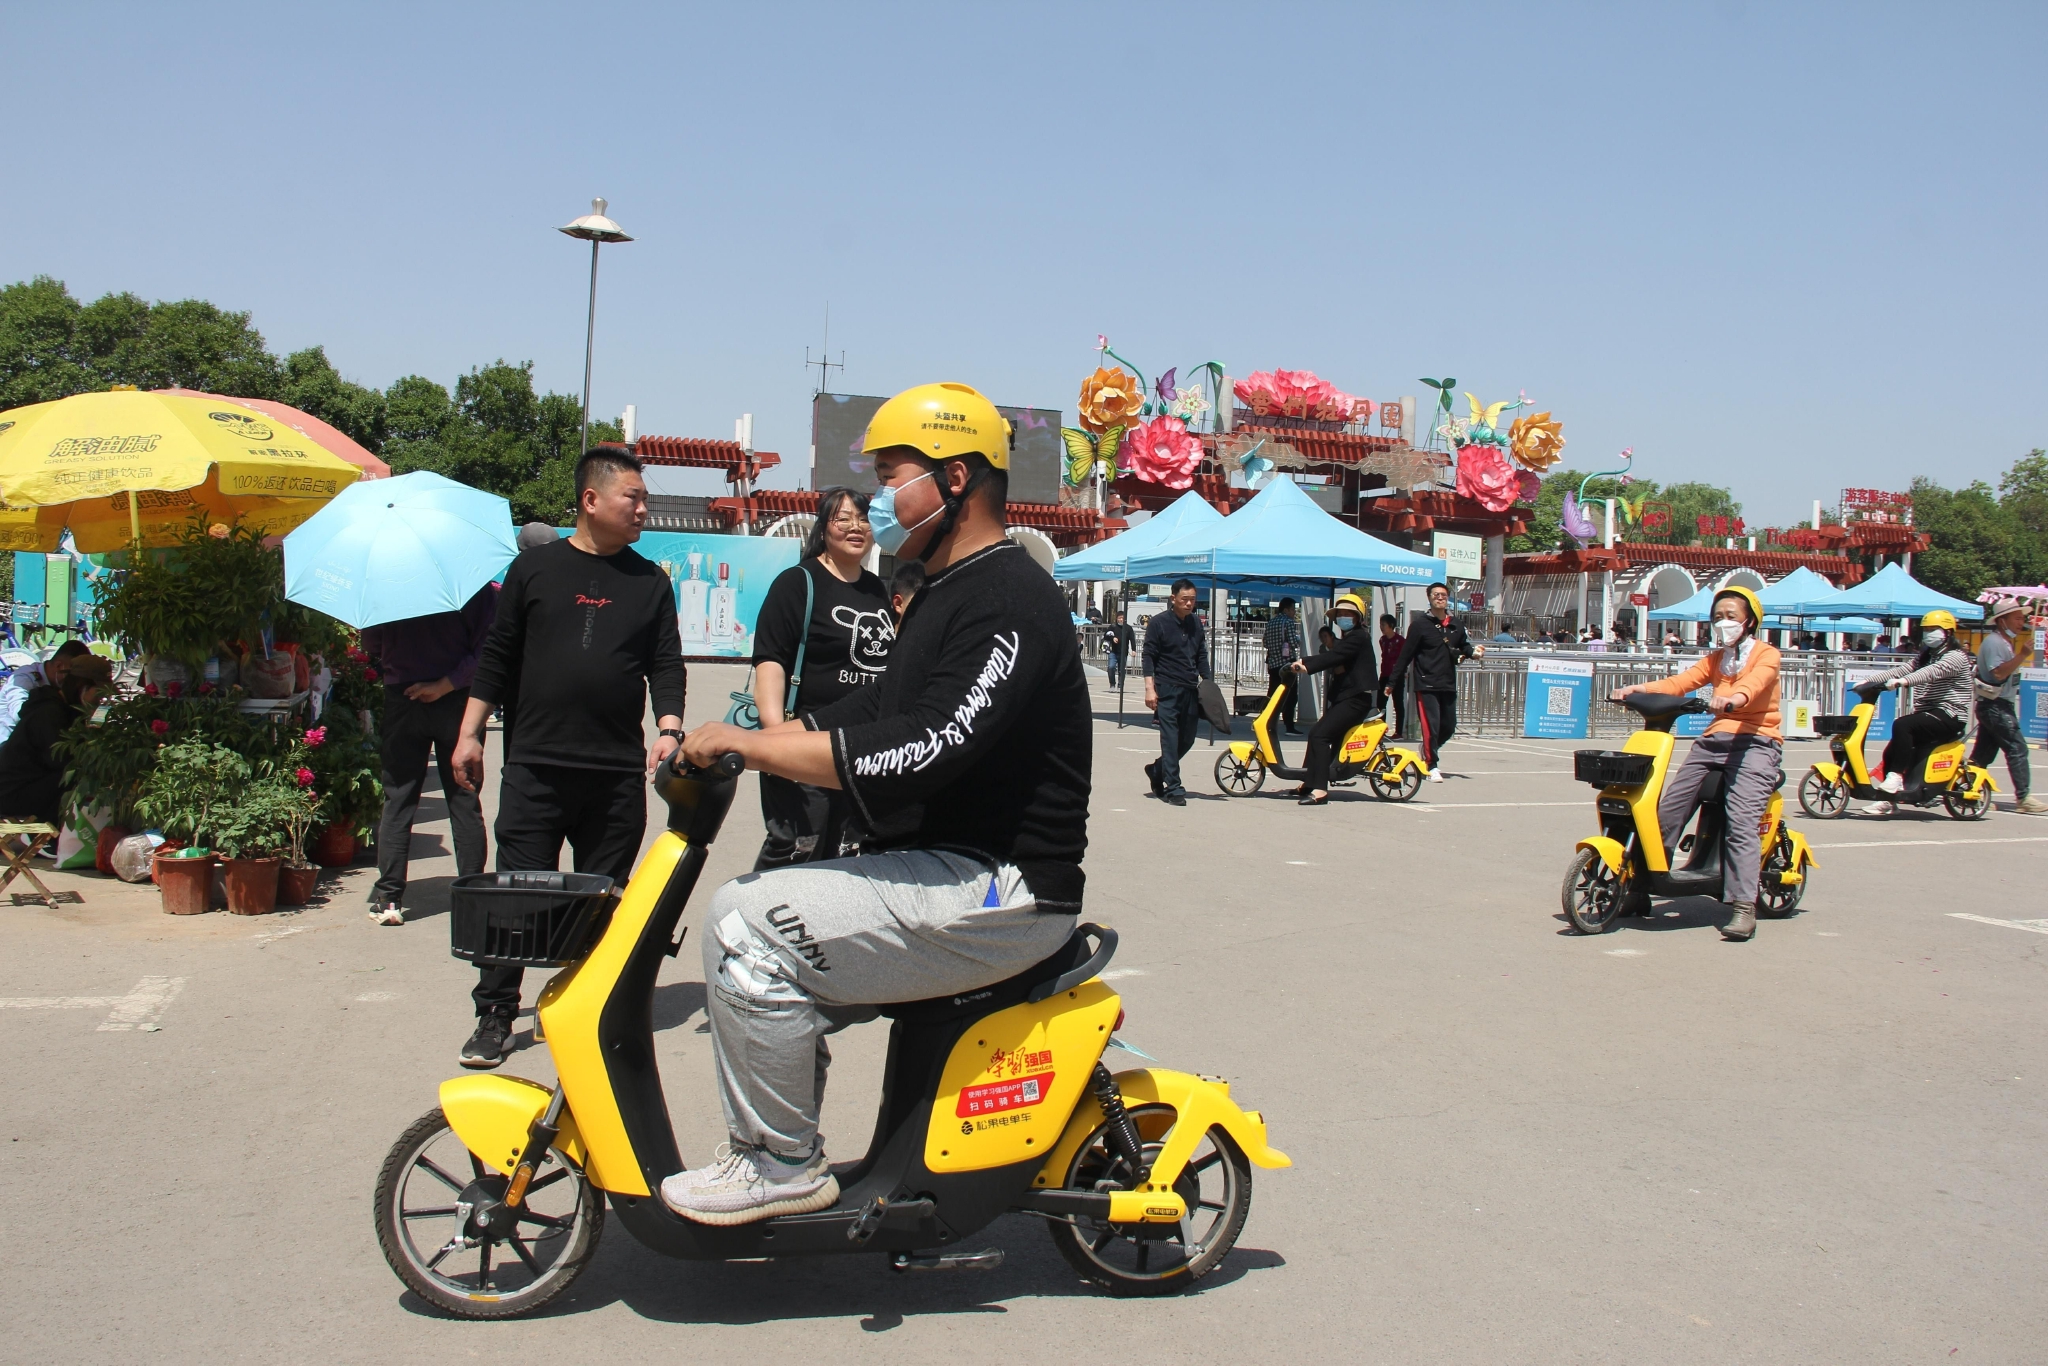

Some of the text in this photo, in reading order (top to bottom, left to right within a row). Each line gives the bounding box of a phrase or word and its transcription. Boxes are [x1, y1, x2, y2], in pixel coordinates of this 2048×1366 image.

[935, 412, 967, 422] 头盔共享
[921, 423, 978, 435] 请不要带走他人的生命
[49, 435, 162, 457] 解油腻
[44, 454, 140, 465] GREASY SOLUTION
[54, 467, 153, 485] 纯正健康饮品
[1697, 515, 1746, 536] 售票处
[1765, 527, 1819, 550] Tickets
[1450, 549, 1476, 560] 证件入口
[1380, 564, 1433, 578] HONOR 荣耀
[939, 722, 965, 746] &
[855, 727, 943, 776] Fashion
[968, 1083, 1022, 1098] 使用学习强国APP
[970, 1095, 1022, 1112] 扫码骑车
[976, 1112, 1032, 1131] 松果电单车
